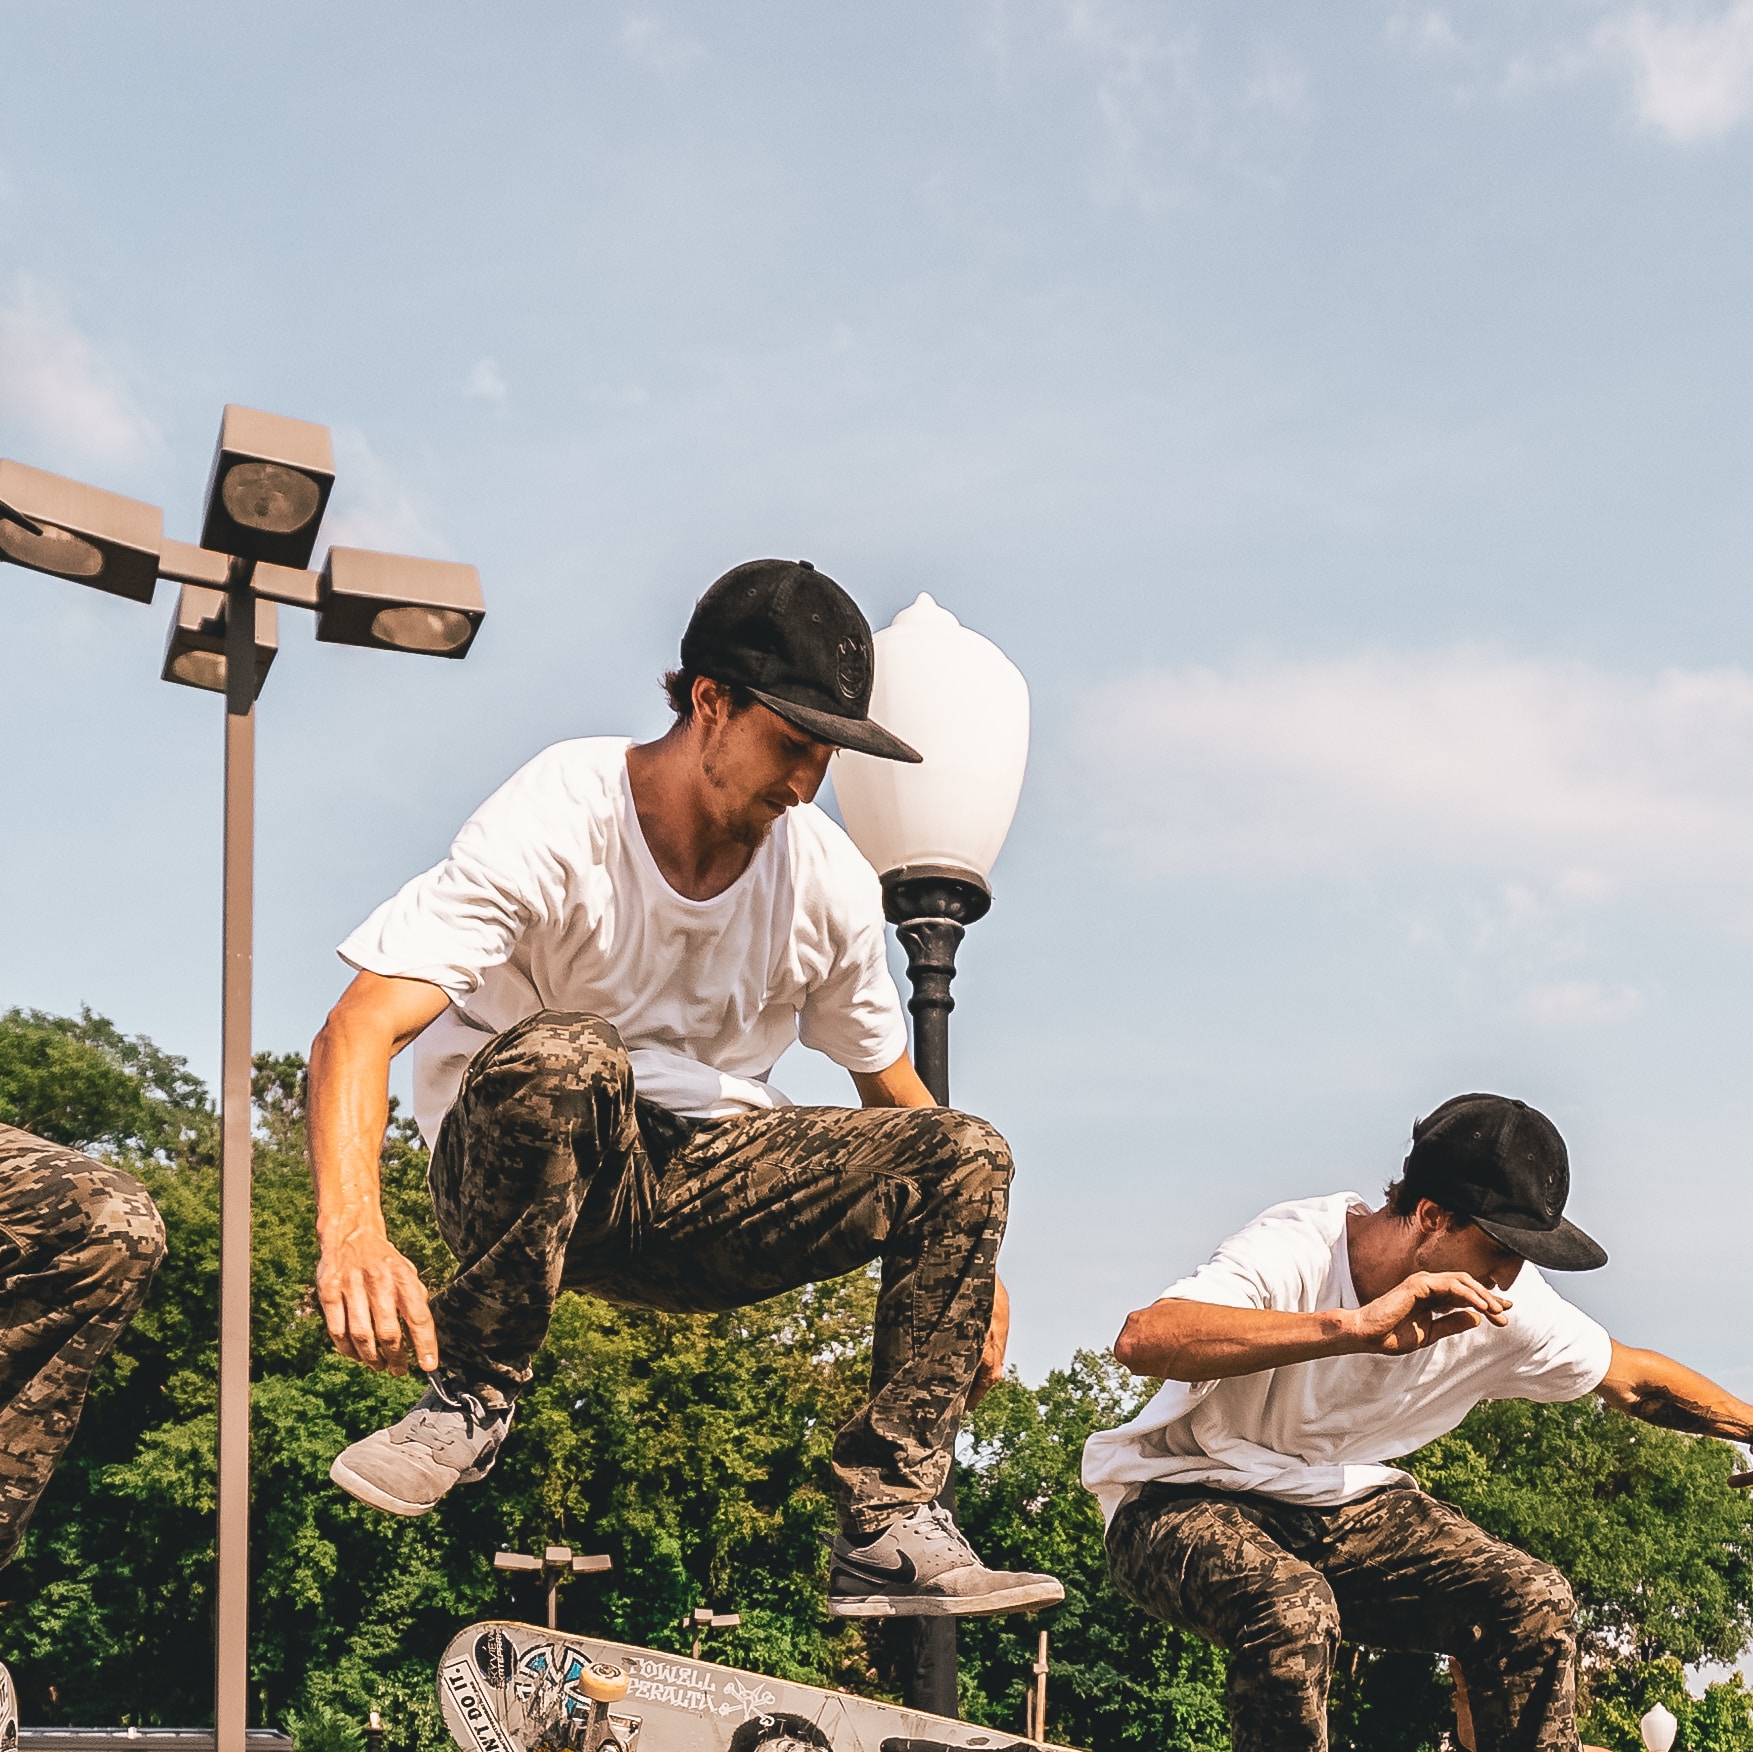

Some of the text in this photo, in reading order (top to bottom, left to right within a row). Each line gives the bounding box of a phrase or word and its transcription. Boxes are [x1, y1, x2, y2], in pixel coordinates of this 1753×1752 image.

[449, 1668, 468, 1691] IT.
[461, 1695, 482, 1720] DO
[626, 1677, 718, 1713] PERALTA
